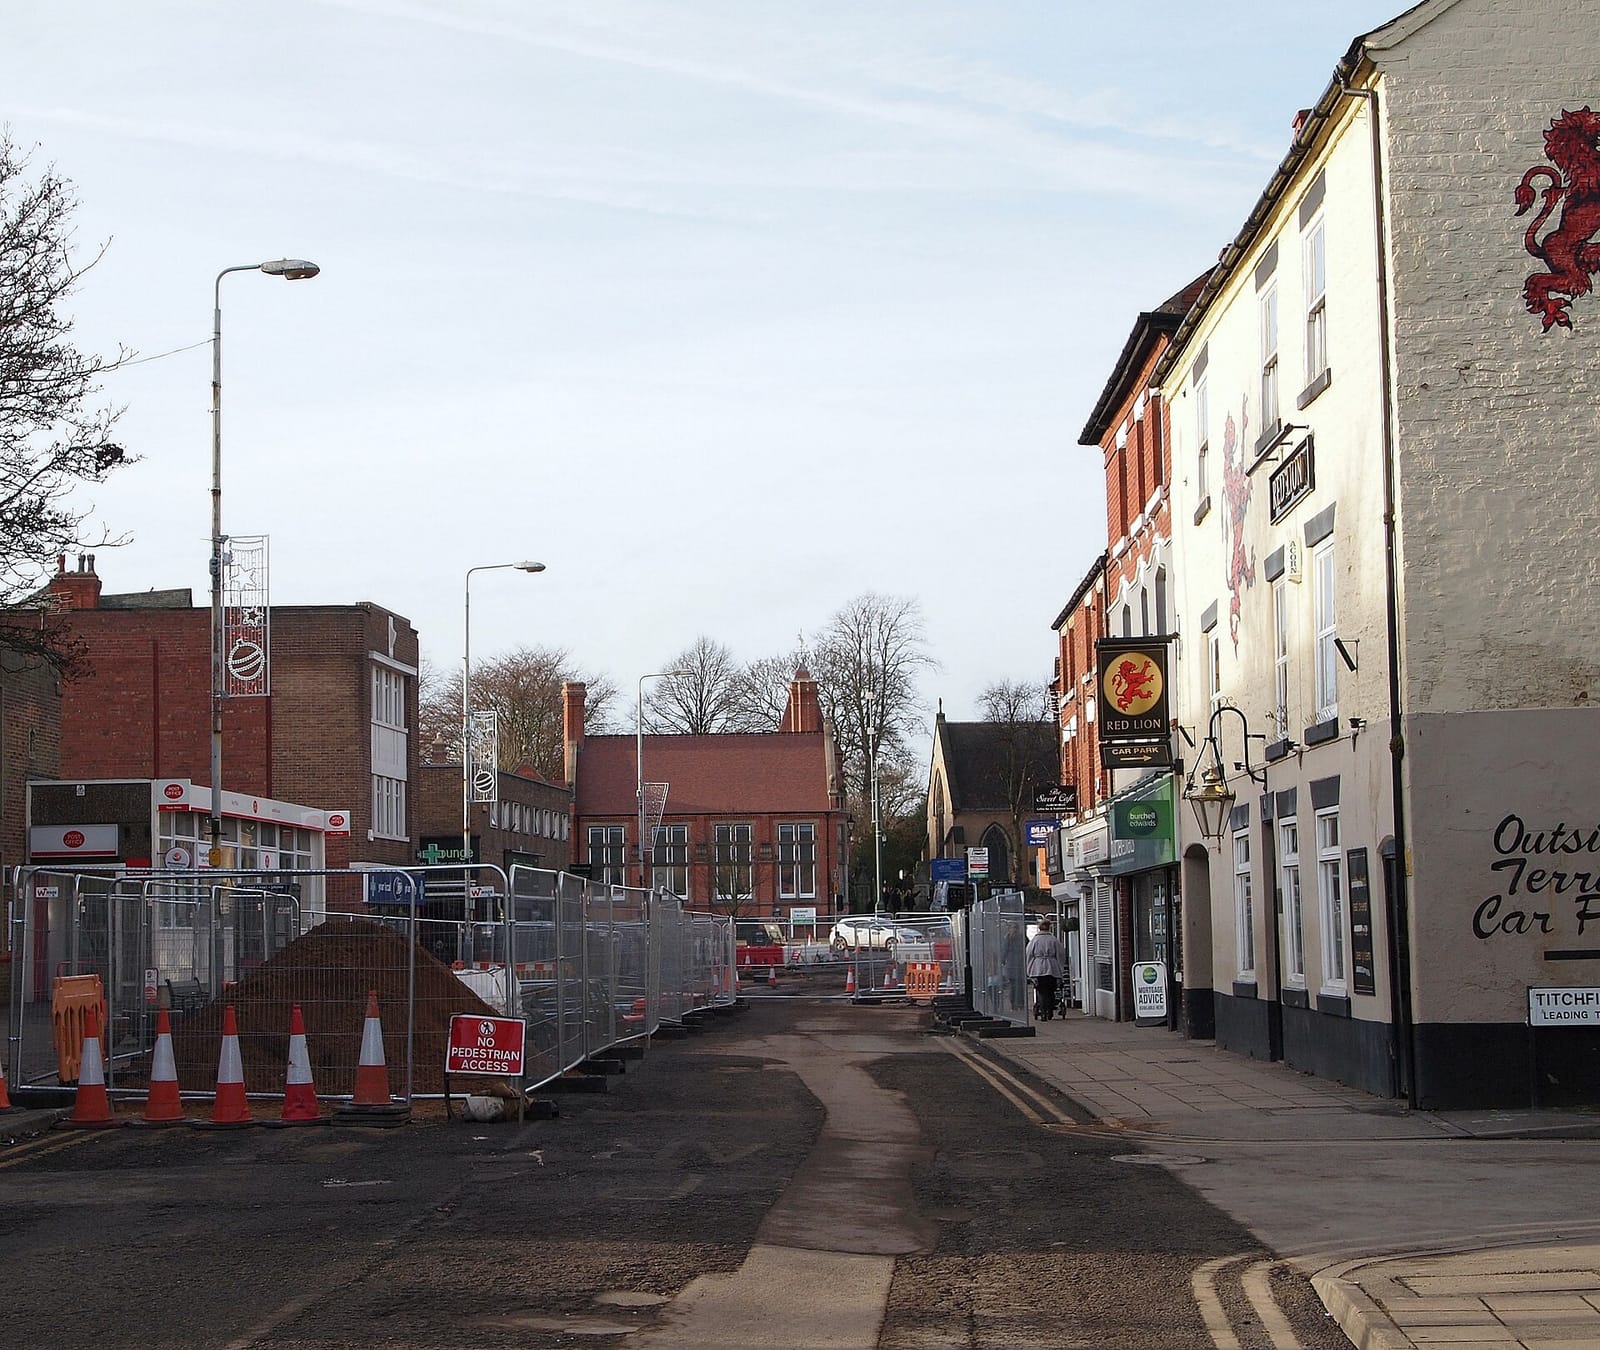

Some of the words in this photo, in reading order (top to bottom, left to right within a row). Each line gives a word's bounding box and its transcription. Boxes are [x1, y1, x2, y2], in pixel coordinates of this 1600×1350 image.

[1106, 720, 1130, 731] RED
[1133, 719, 1162, 730] LION
[1111, 748, 1132, 756] CAR
[1036, 793, 1057, 803] Sweet
[1129, 811, 1156, 820] burchell
[1129, 819, 1157, 827] edwards
[1031, 825, 1054, 833] MAX
[1472, 894, 1555, 939] Car
[1138, 994, 1164, 1004] ADVICE
[1535, 992, 1599, 1006] TITCHFI
[1542, 1010, 1589, 1020] LEADING
[477, 1036, 496, 1048] NO
[451, 1047, 521, 1061] PEDESTRIAN
[461, 1059, 510, 1072] ACCESS
